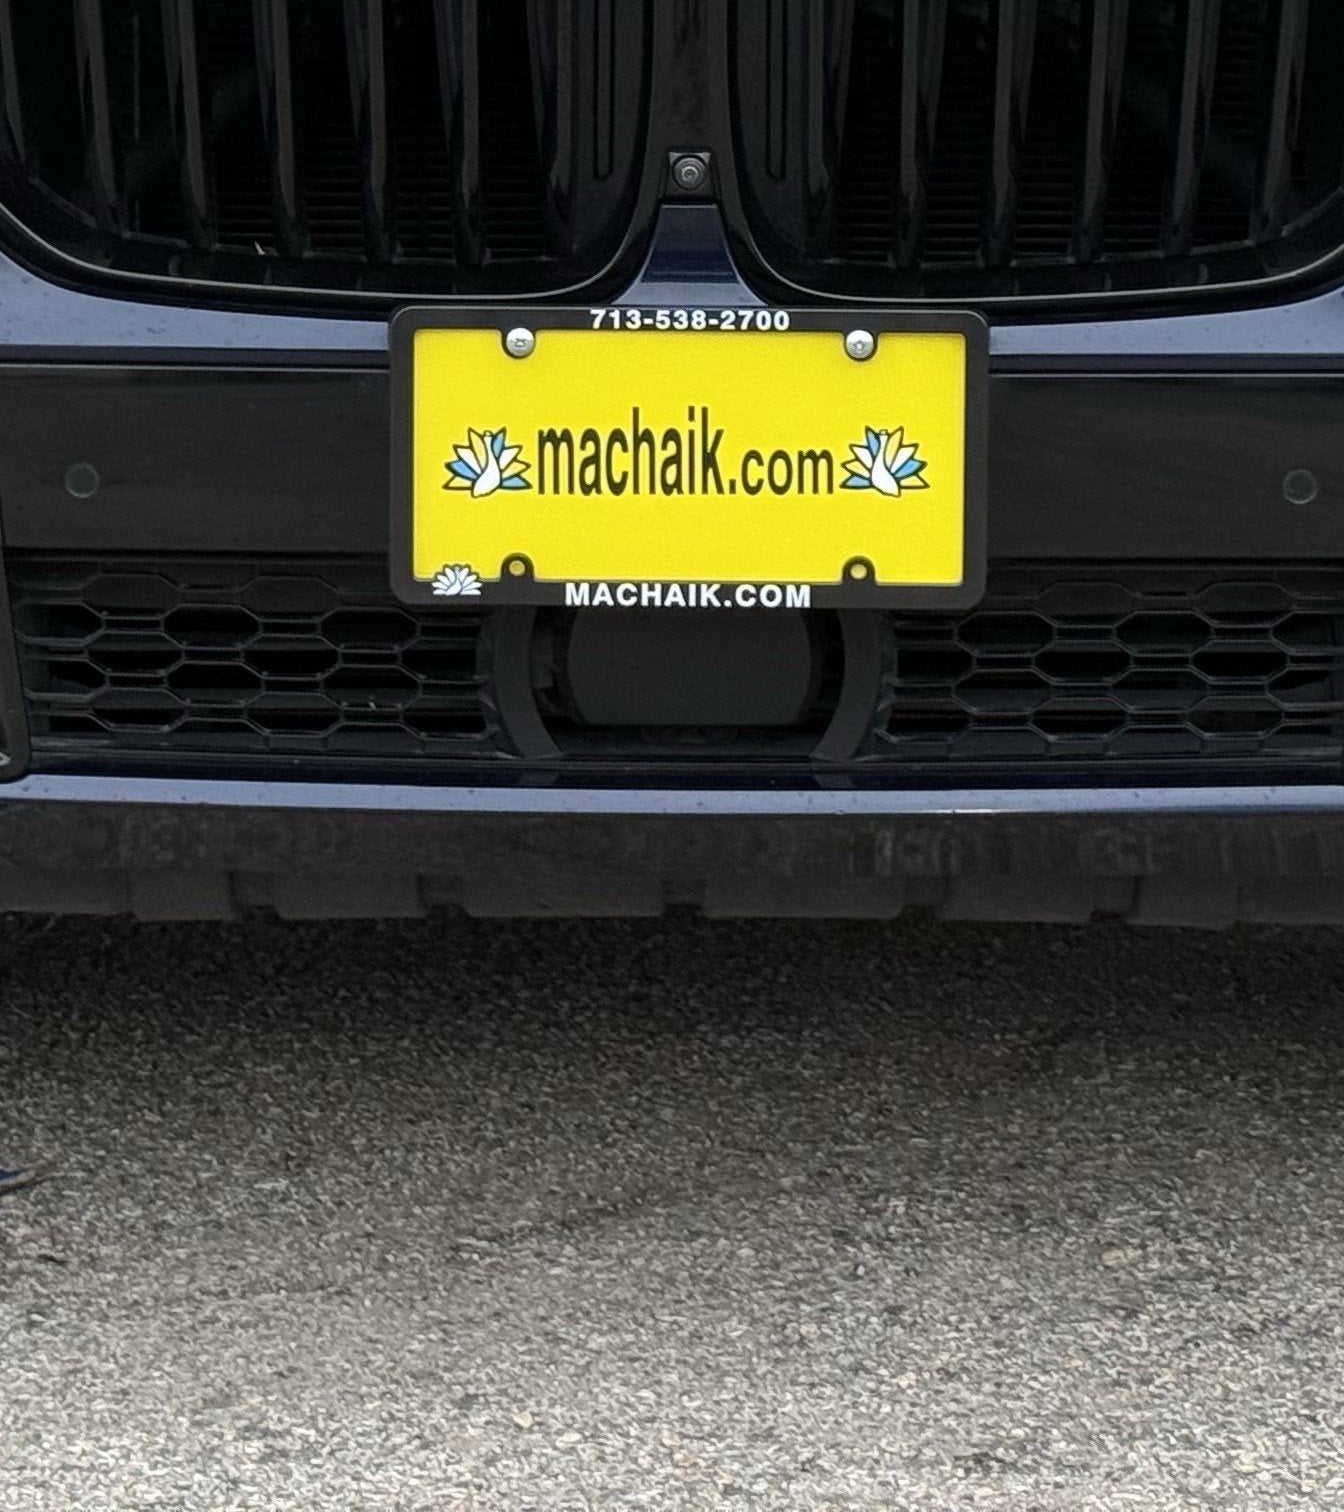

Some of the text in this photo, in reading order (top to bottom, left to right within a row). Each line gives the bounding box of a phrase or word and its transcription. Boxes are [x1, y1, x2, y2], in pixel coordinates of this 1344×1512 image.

[590, 309, 790, 330] 713-538-2700
[537, 406, 834, 496] machaik.com
[565, 583, 811, 608] MACHAIK.COM
